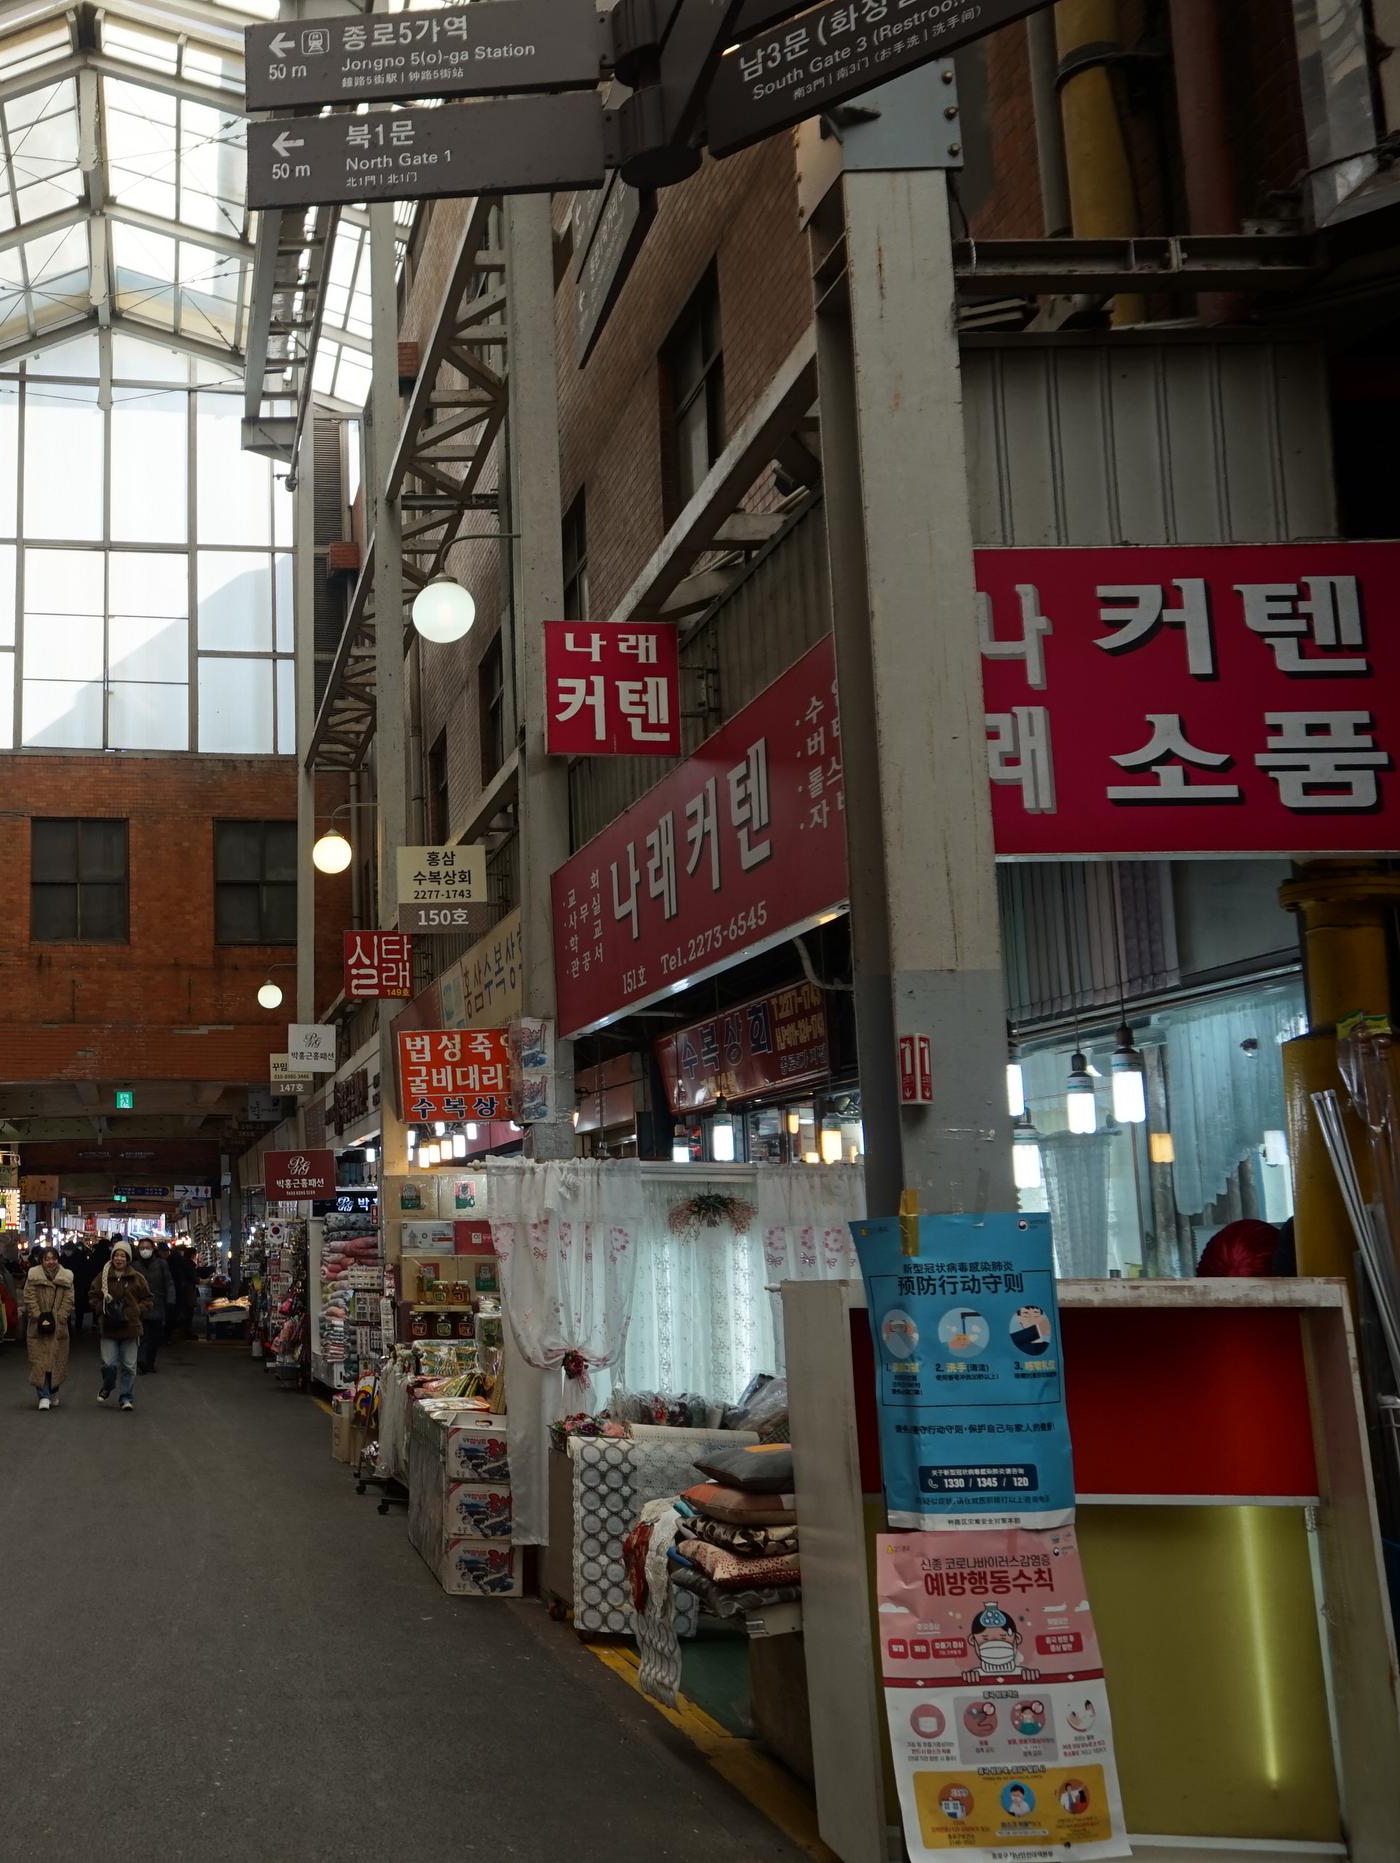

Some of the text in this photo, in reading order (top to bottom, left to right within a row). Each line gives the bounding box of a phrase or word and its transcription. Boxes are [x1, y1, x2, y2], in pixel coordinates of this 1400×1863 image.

[342, 16, 468, 51] 종로5가역
[342, 43, 536, 72] Jongno 5(o)-ga Station
[739, 27, 810, 83] 남3문
[269, 64, 307, 80] 50 m
[752, 68, 804, 101] South
[809, 48, 851, 74] Gate
[856, 37, 868, 51] 3
[346, 120, 415, 149] 북1문
[272, 164, 311, 179] 50 m
[346, 150, 452, 171] North Gate 1
[1092, 575, 1369, 676] 커텐
[564, 632, 658, 664] 나래
[555, 675, 670, 742] 커텐
[1105, 710, 1390, 808] 소품
[426, 851, 456, 867] 홍삼
[413, 870, 472, 886] 수복상회
[413, 889, 472, 900] 2277-1743
[418, 908, 469, 926] 150호
[622, 901, 768, 996] 151호 Tel.2273-6545
[680, 1000, 774, 1080] 수복상회
[279, 1083, 305, 1093] 147호
[407, 1063, 511, 1094] 굴비대리
[276, 1178, 324, 1189] 박홍근홈패션
[903, 1260, 1014, 1274] 新型冠状病毒感染肺炎
[898, 1272, 1024, 1297] 预防行动守则
[942, 1477, 965, 1489] 1330
[976, 1477, 998, 1488] 1345
[1012, 1476, 1029, 1487] 120
[920, 1554, 1051, 1571] 신종 코로나바이러스감염증
[924, 1567, 1055, 1597] 예방행동수칙
